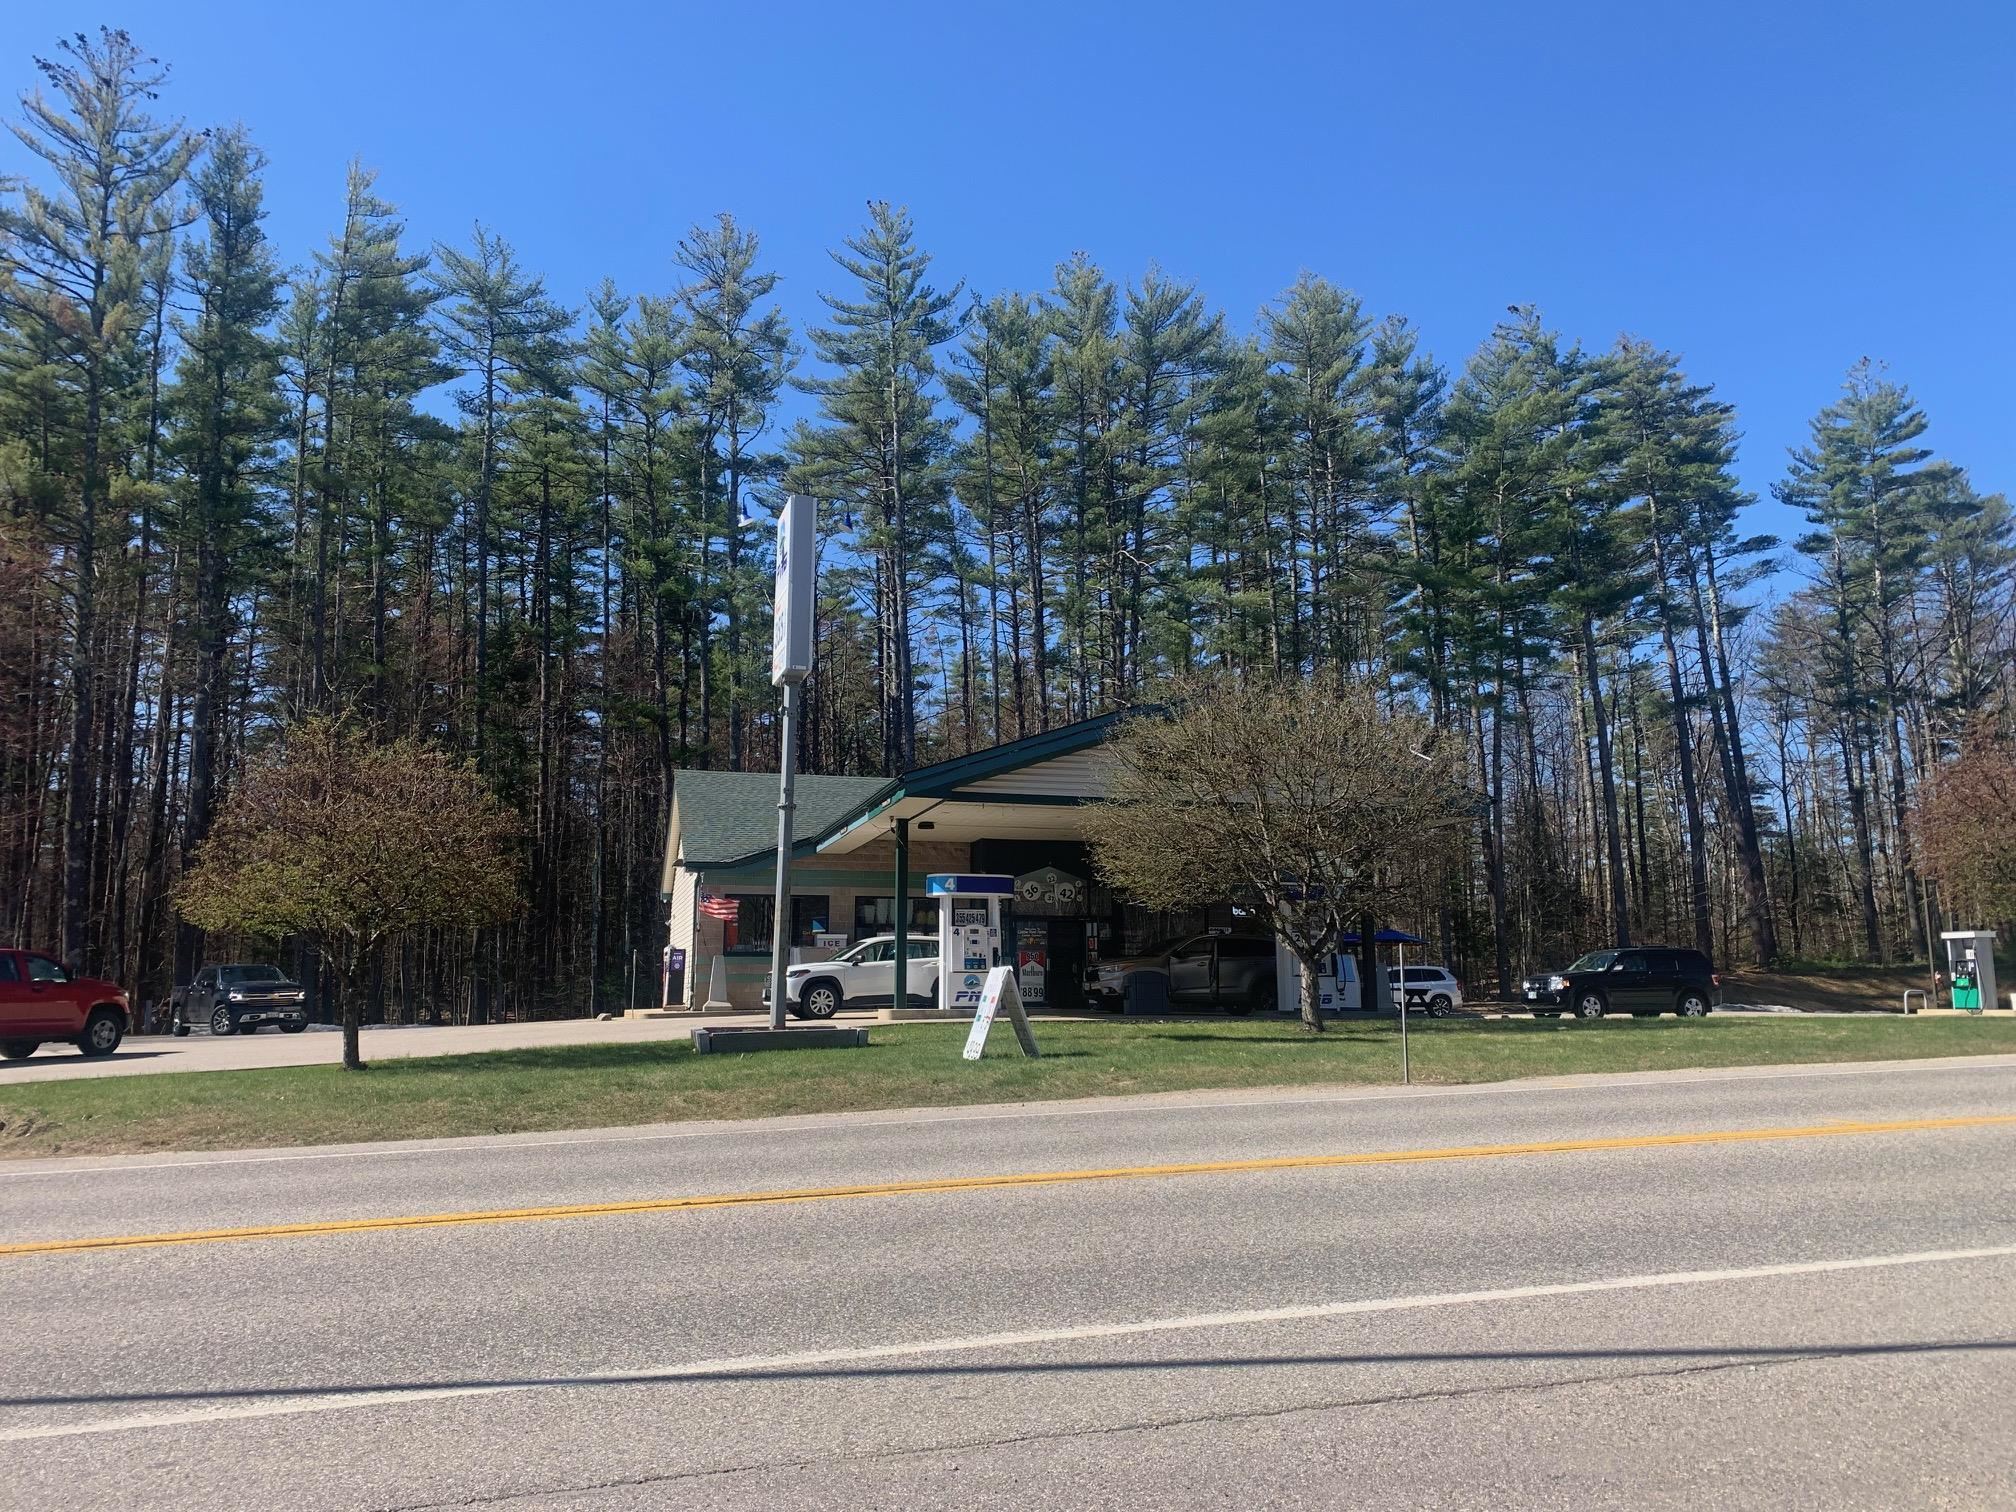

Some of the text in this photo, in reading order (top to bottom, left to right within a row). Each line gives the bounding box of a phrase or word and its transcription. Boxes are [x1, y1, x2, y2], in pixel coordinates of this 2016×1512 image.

[945, 878, 955, 890] 4
[1025, 884, 1038, 899] 36
[1060, 889, 1073, 899] 42
[953, 928, 960, 936] 4
